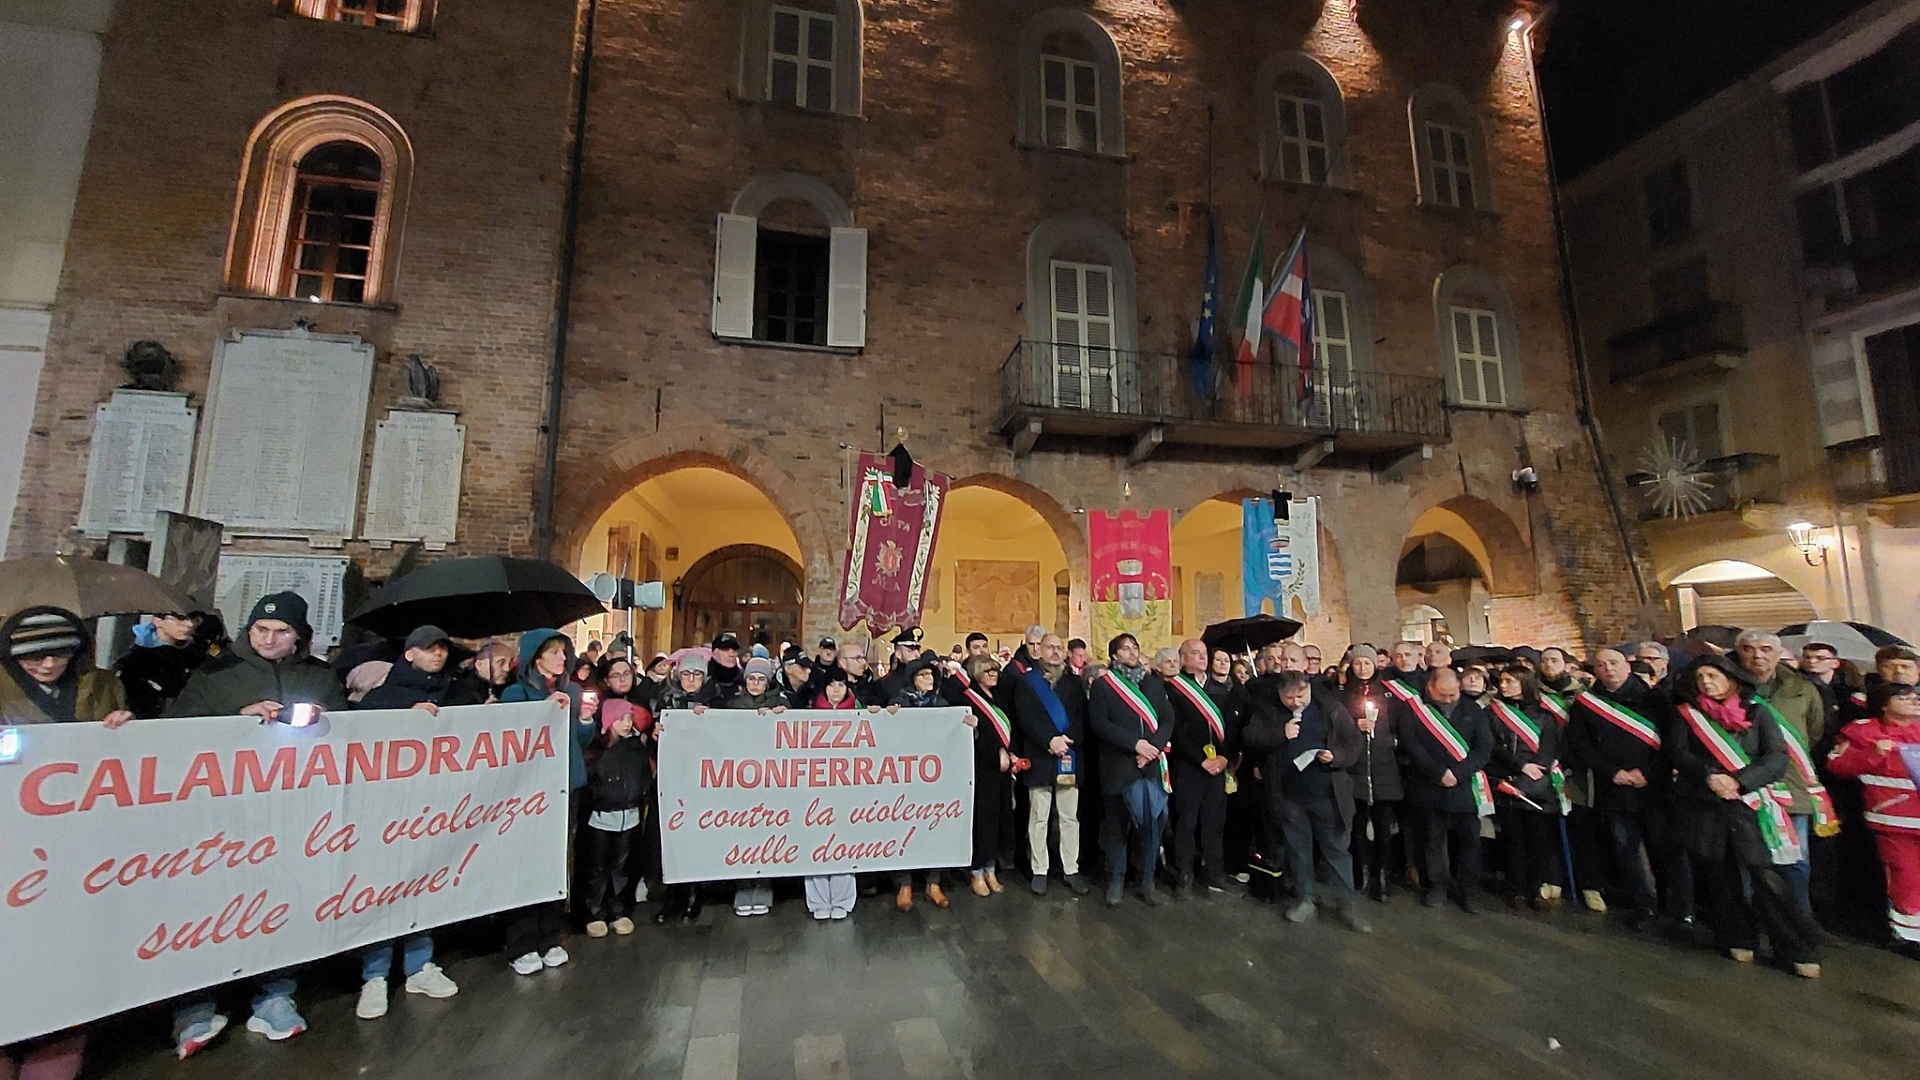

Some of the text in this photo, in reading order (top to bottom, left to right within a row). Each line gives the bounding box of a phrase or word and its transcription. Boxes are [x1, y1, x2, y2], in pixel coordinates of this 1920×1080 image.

[775, 720, 877, 749] NIZZA
[19, 725, 556, 817] CALAMANDRANA
[699, 753, 943, 790] MONFERRATO
[668, 794, 964, 831] è contro la violenza
[6, 789, 550, 908] è contro la violenza
[724, 826, 916, 866] sulle donne!
[136, 843, 480, 960] sulle donne!
